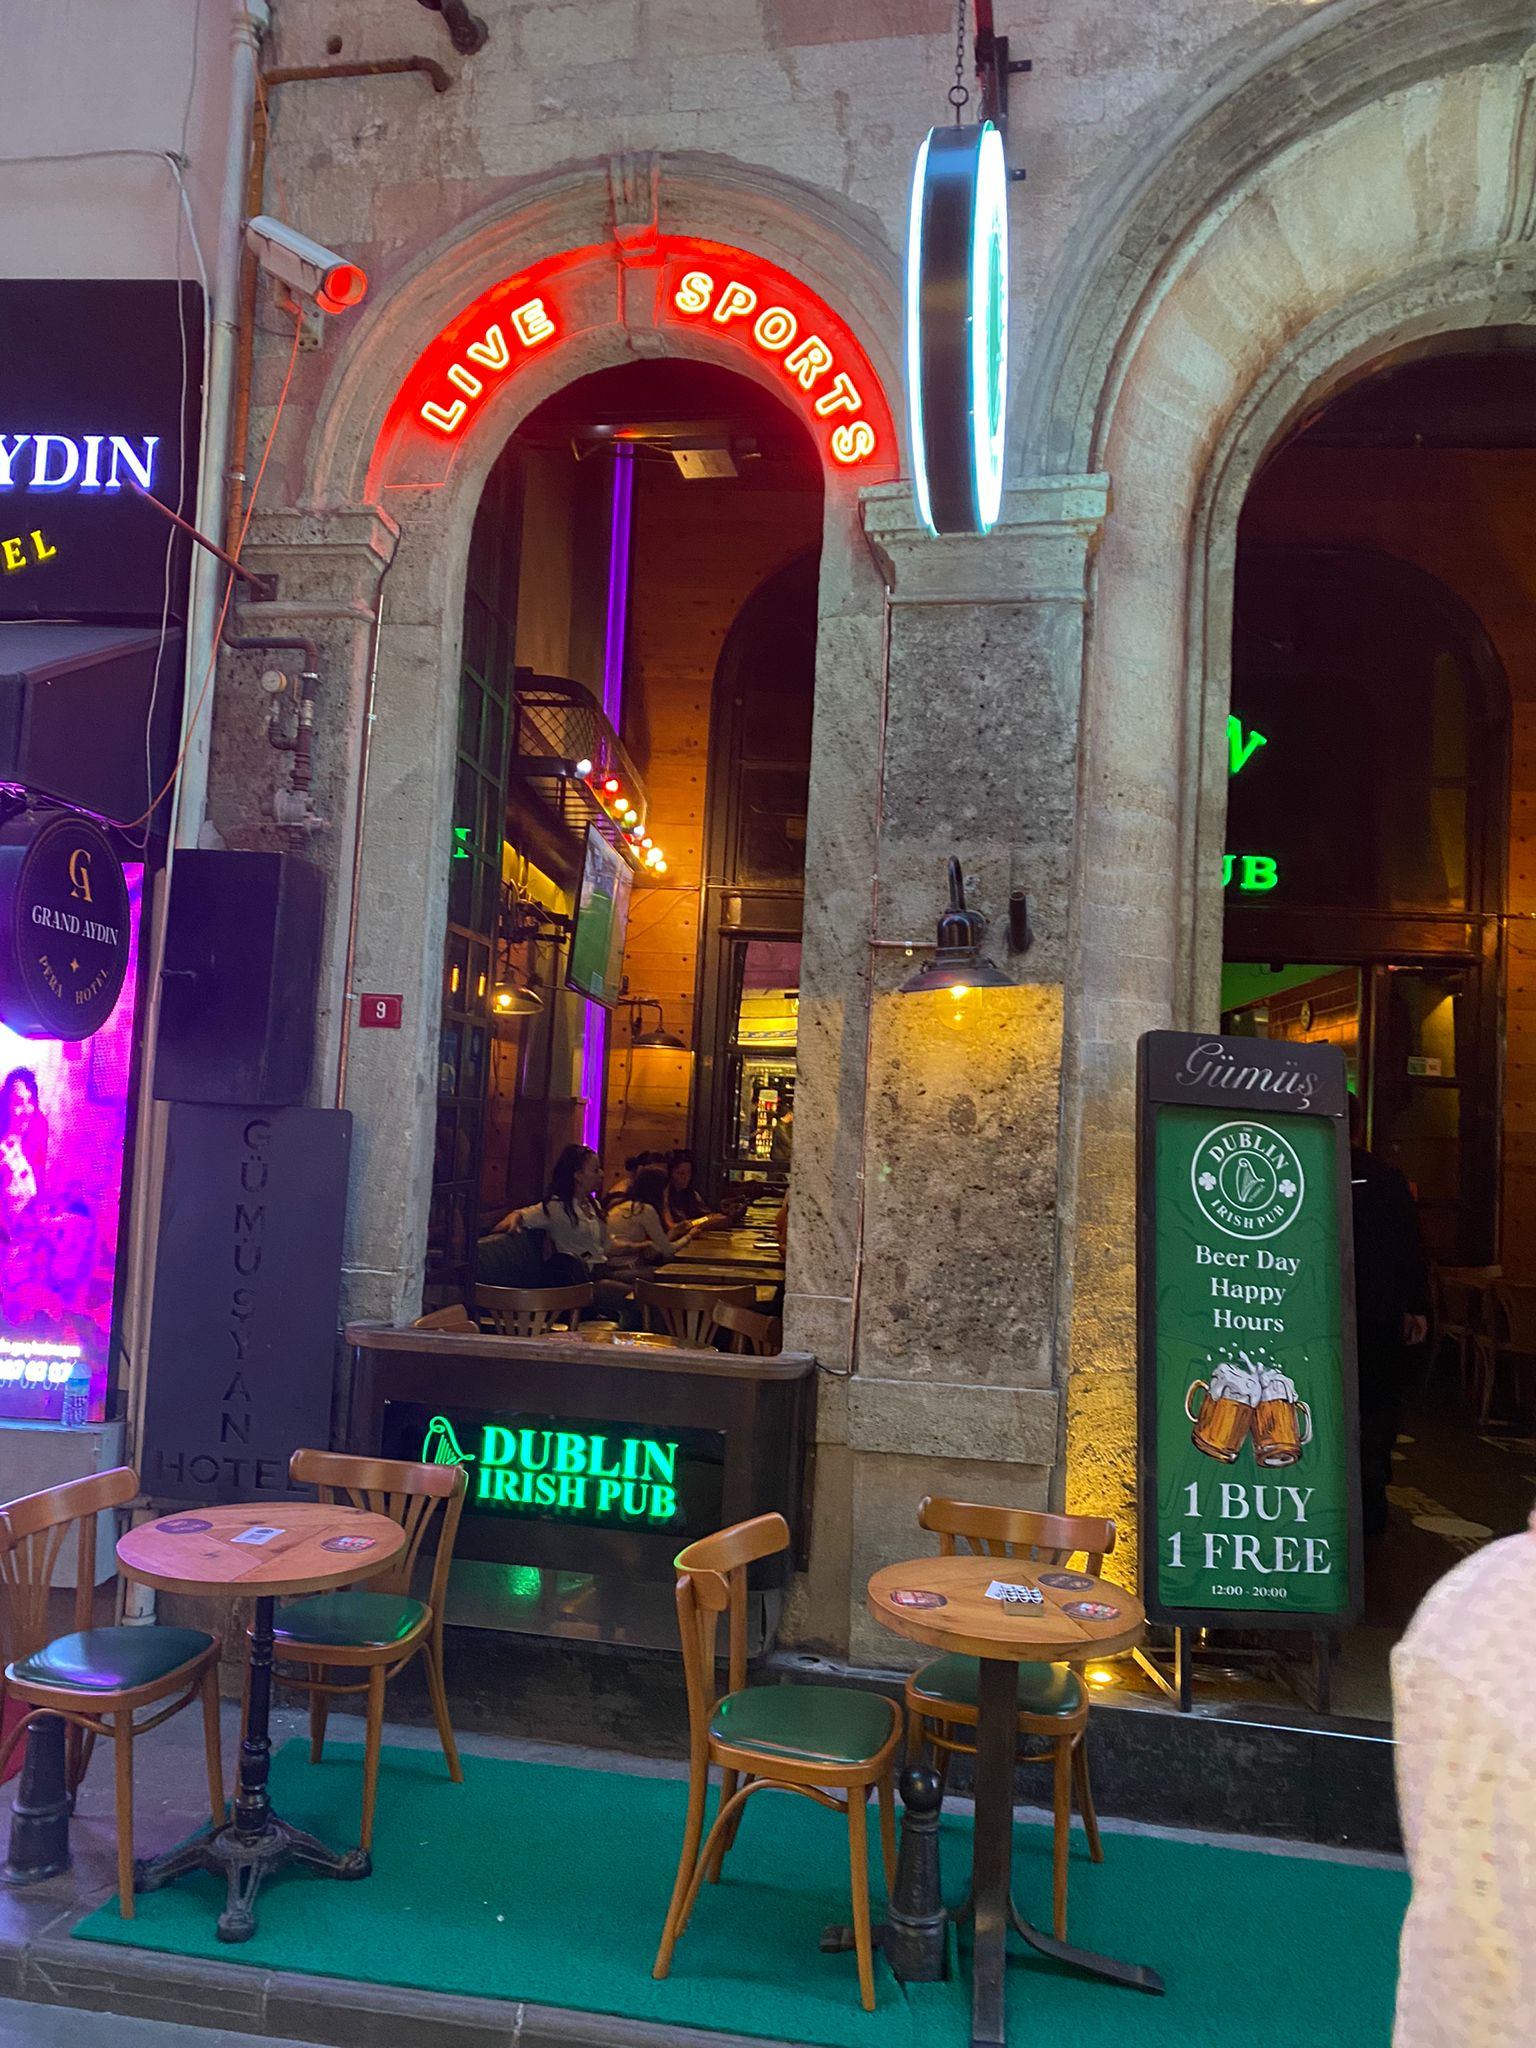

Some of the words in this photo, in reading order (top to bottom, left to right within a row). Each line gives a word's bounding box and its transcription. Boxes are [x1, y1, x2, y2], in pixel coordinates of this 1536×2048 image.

[421, 298, 555, 432] LIVE
[675, 271, 875, 463] SPORTS
[32, 905, 80, 934] GRAND
[82, 920, 118, 946] AYDIN
[39, 955, 62, 998] PERA
[75, 968, 109, 1004] HOTEL
[376, 1001, 386, 1019] 9
[1175, 1041, 1320, 1110] Gümüş
[1208, 1132, 1289, 1170] DUBLIN
[1211, 1199, 1254, 1229] IRISH
[1256, 1205, 1285, 1228] PUB
[1195, 1244, 1249, 1268] Beer
[1257, 1249, 1301, 1276] Day
[1210, 1277, 1287, 1306] Happy
[1213, 1308, 1285, 1333] Hours
[480, 1426, 679, 1484] DUBLIN
[477, 1467, 588, 1508] IRISH
[598, 1478, 677, 1518] PUB
[1183, 1481, 1202, 1518] 1
[1219, 1482, 1316, 1523] BUY
[1167, 1531, 1186, 1569] 1
[1202, 1532, 1332, 1575] FREE
[1211, 1585, 1243, 1596] 12:00
[1252, 1586, 1287, 1598] 20:00
